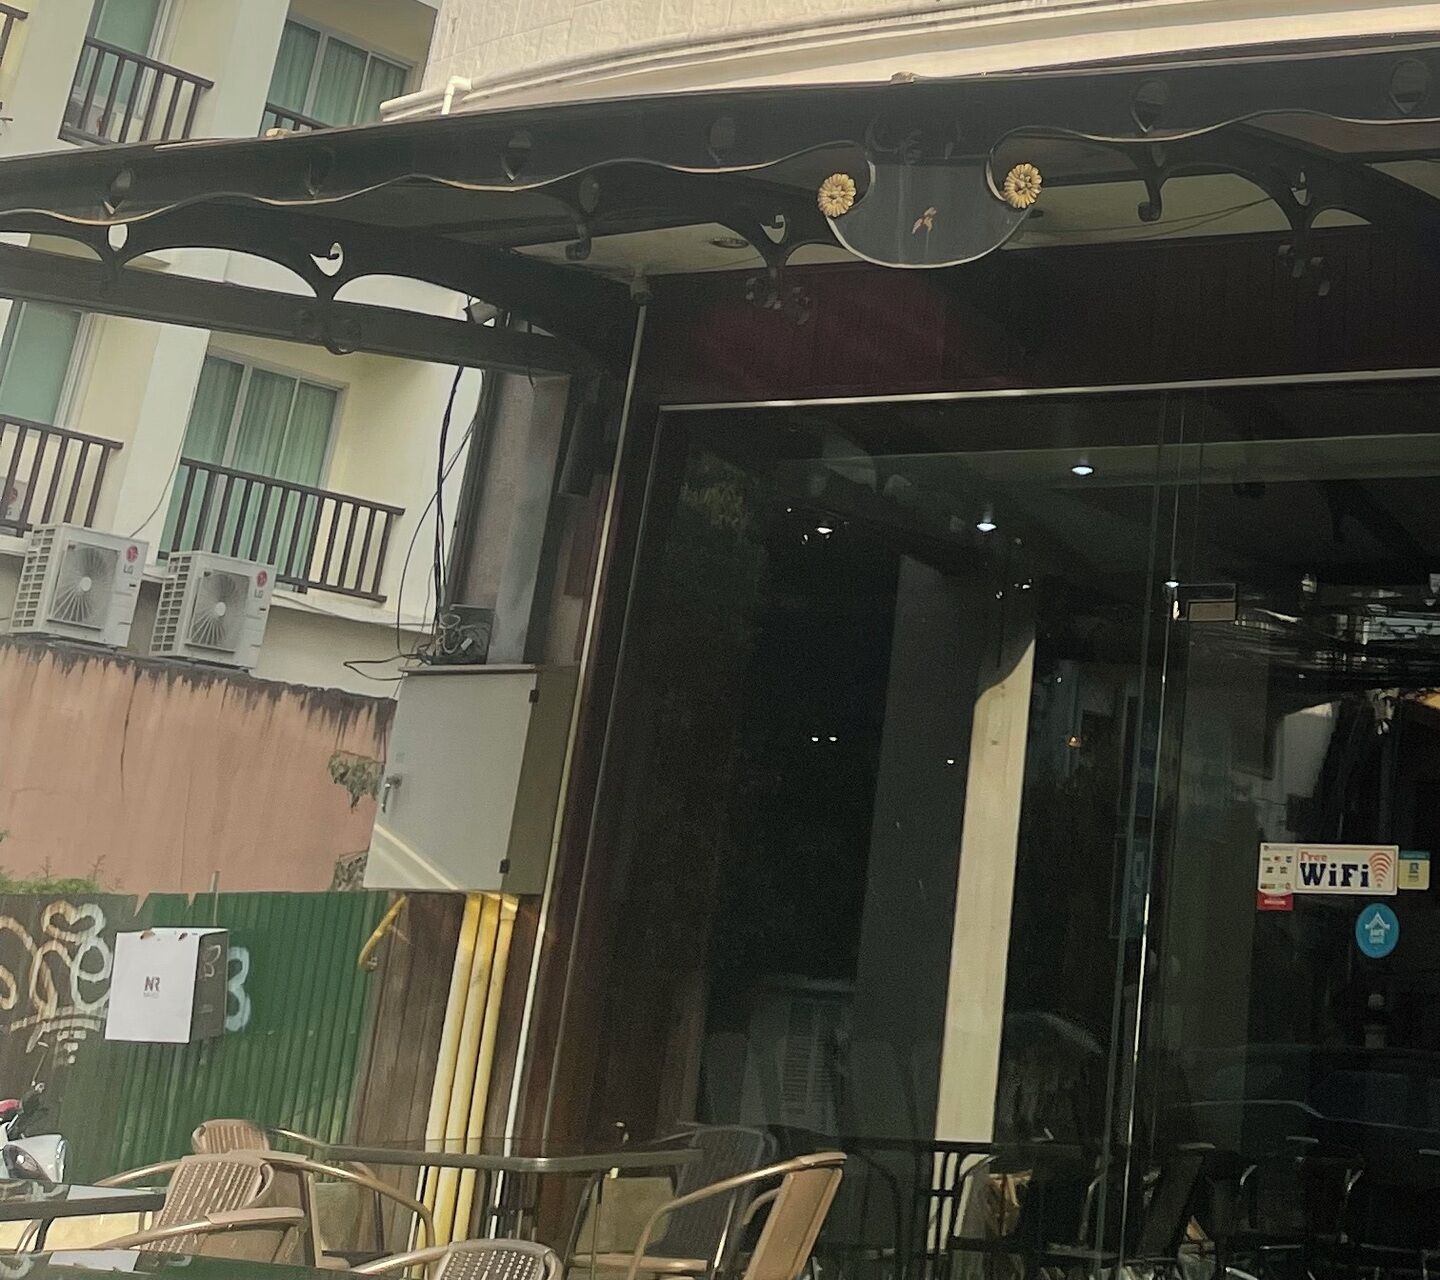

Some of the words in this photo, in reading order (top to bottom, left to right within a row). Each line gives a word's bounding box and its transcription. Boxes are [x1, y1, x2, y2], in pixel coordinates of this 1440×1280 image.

[123, 564, 134, 575] LG
[254, 589, 264, 599] LG
[1300, 851, 1328, 862] Free
[1299, 862, 1370, 888] WiFi
